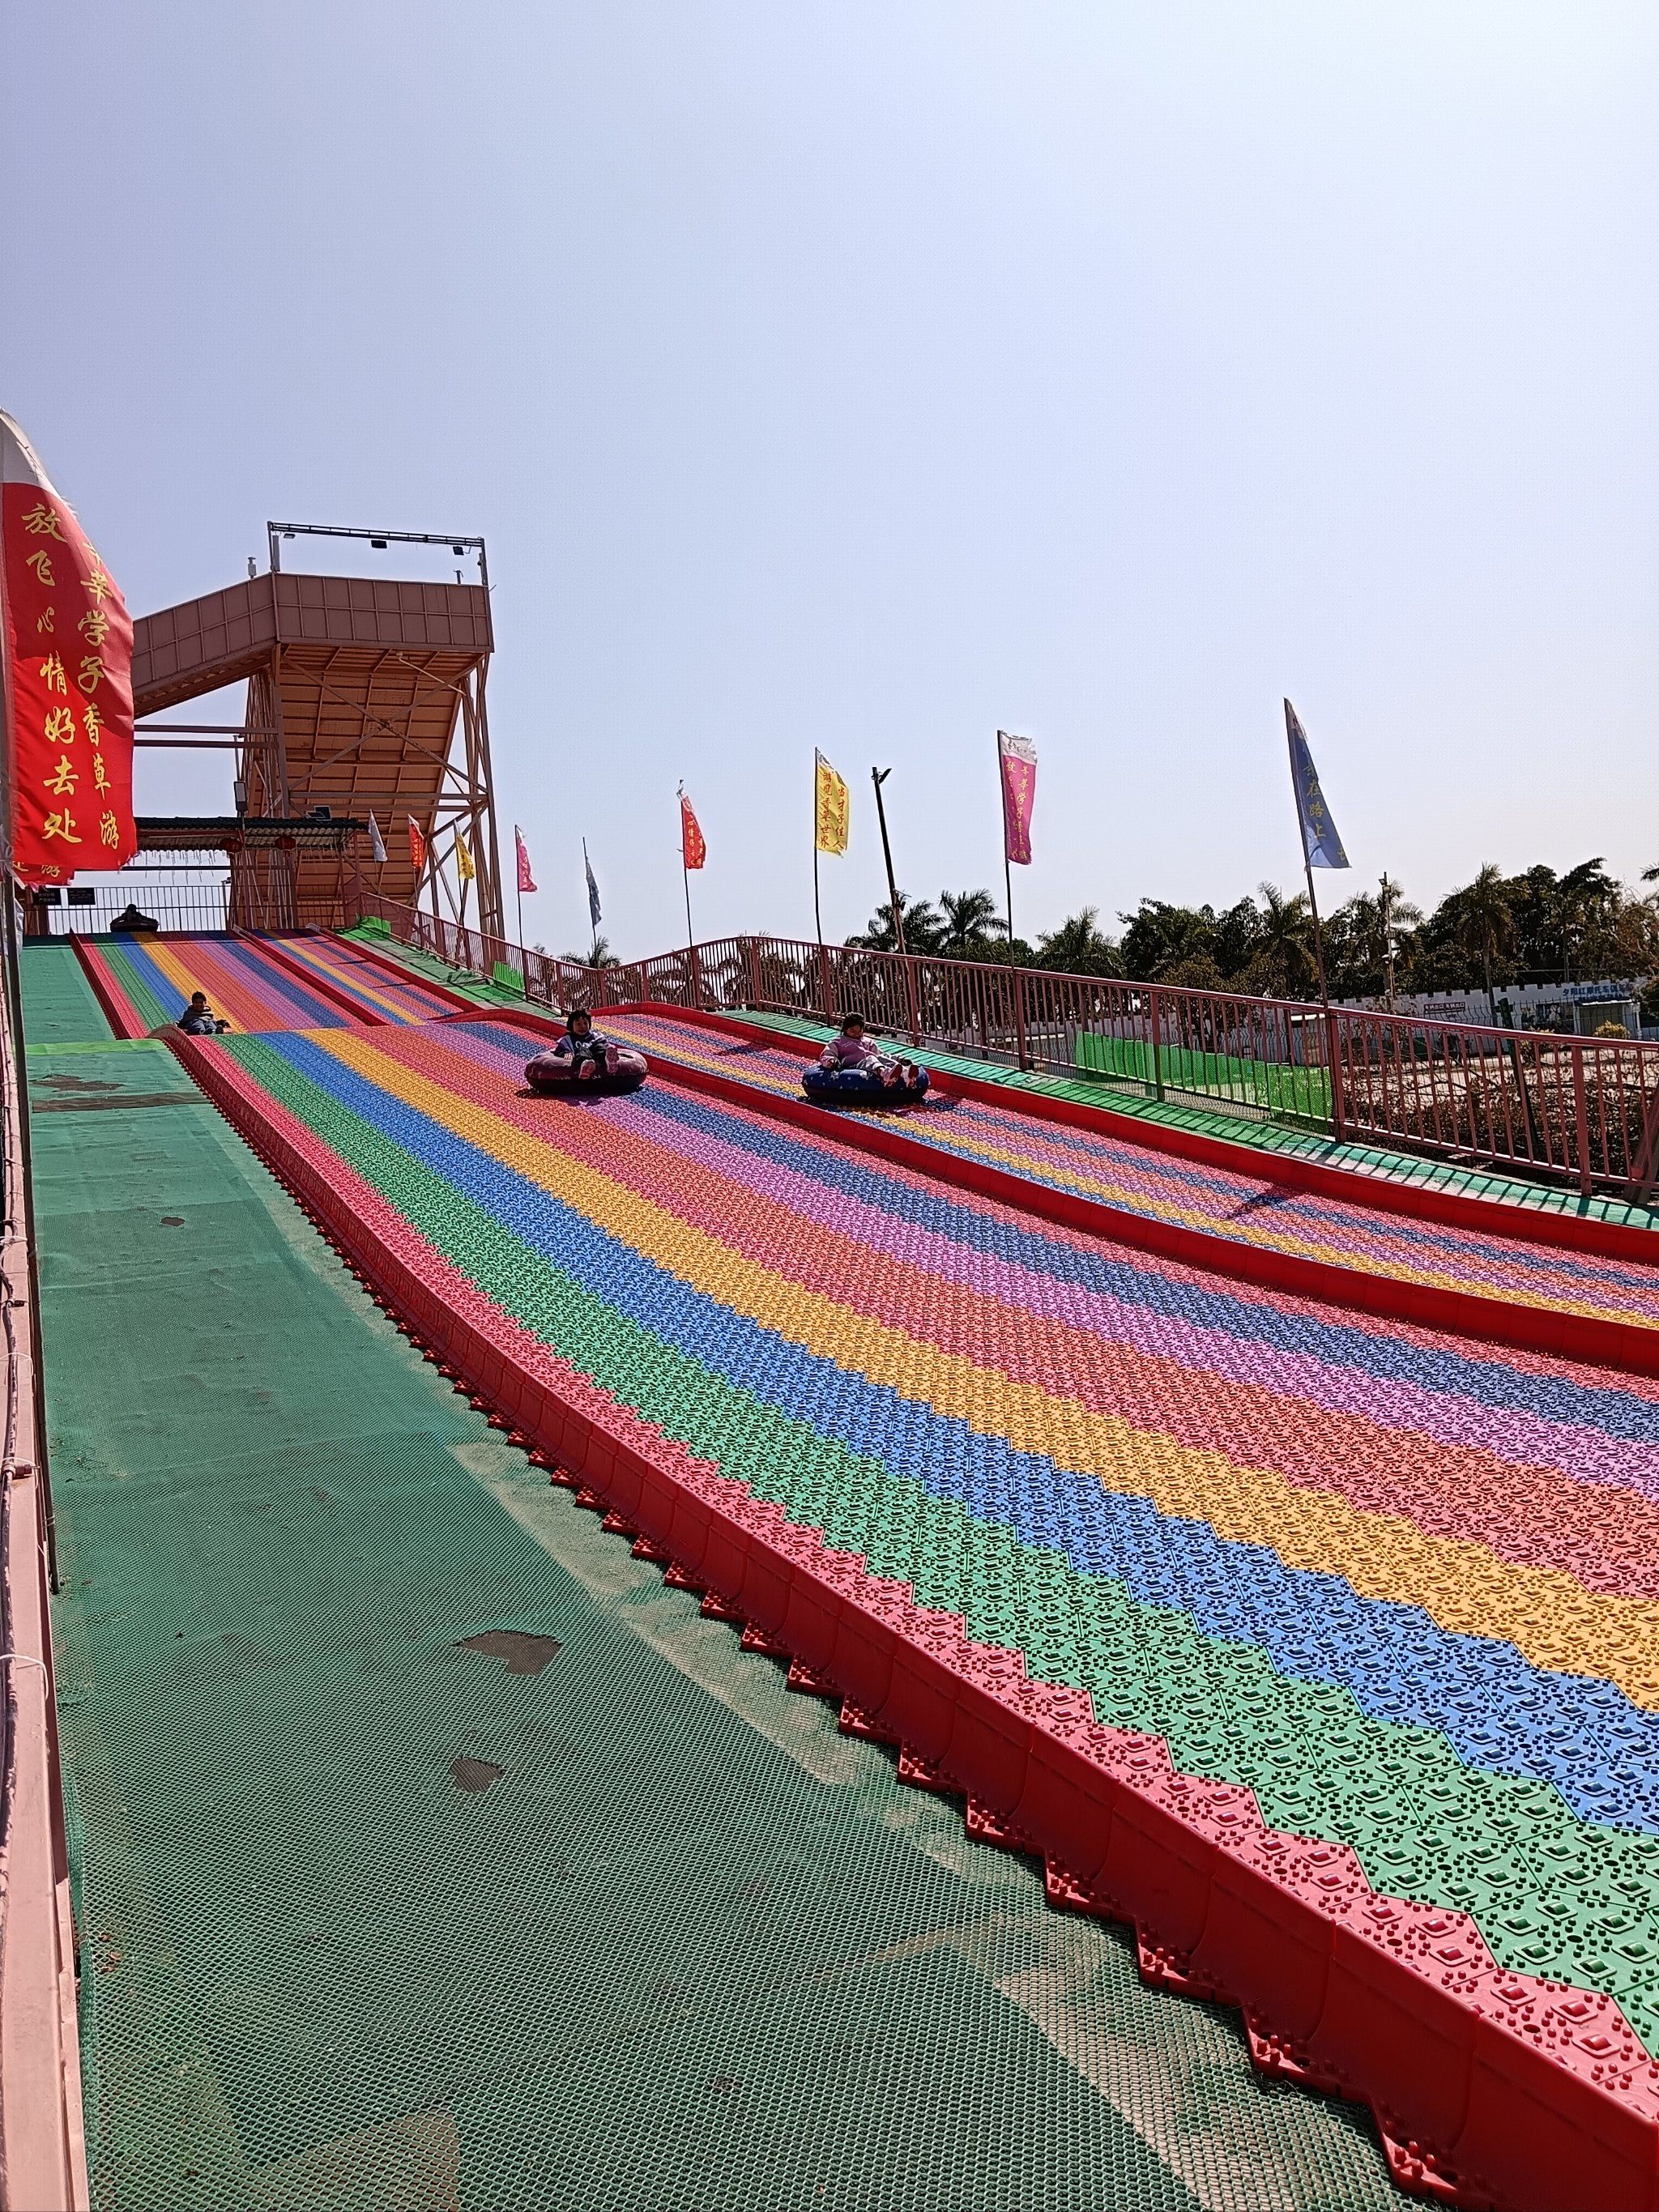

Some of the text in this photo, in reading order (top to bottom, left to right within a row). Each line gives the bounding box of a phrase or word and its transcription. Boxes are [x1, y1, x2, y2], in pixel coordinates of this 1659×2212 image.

[21, 502, 82, 844] 放飞心情好去处
